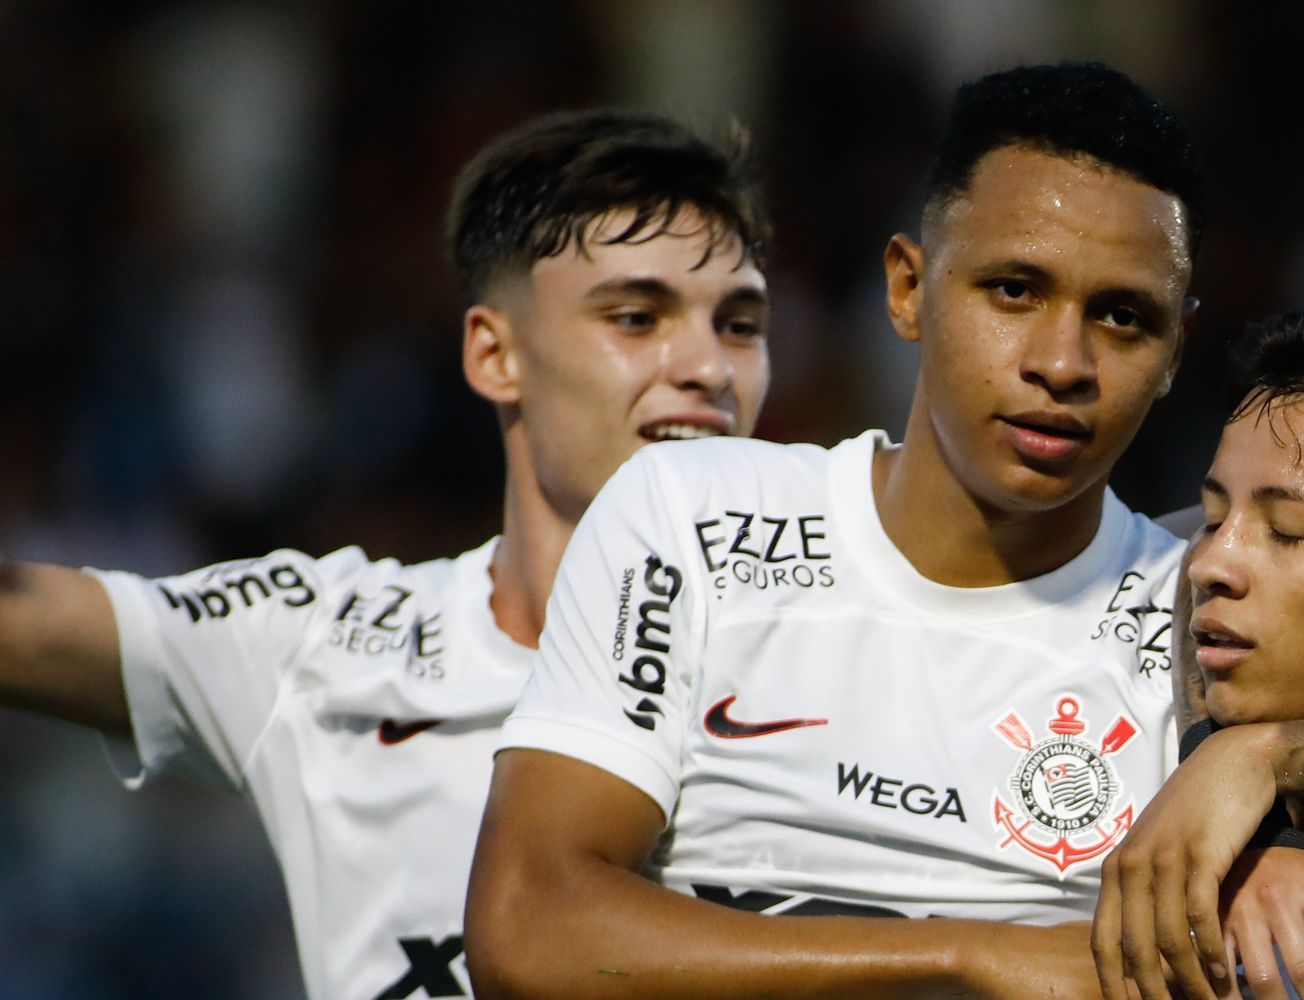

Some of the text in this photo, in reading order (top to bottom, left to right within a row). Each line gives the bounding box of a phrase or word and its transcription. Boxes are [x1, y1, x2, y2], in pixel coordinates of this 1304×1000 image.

[695, 510, 832, 573] EZZE
[613, 567, 636, 662] CORINTHIANS
[617, 553, 684, 696] bmg
[836, 762, 967, 823] WEGA
[1021, 743, 1092, 792] CORINTHIANS
[1050, 817, 1081, 829] 1910
